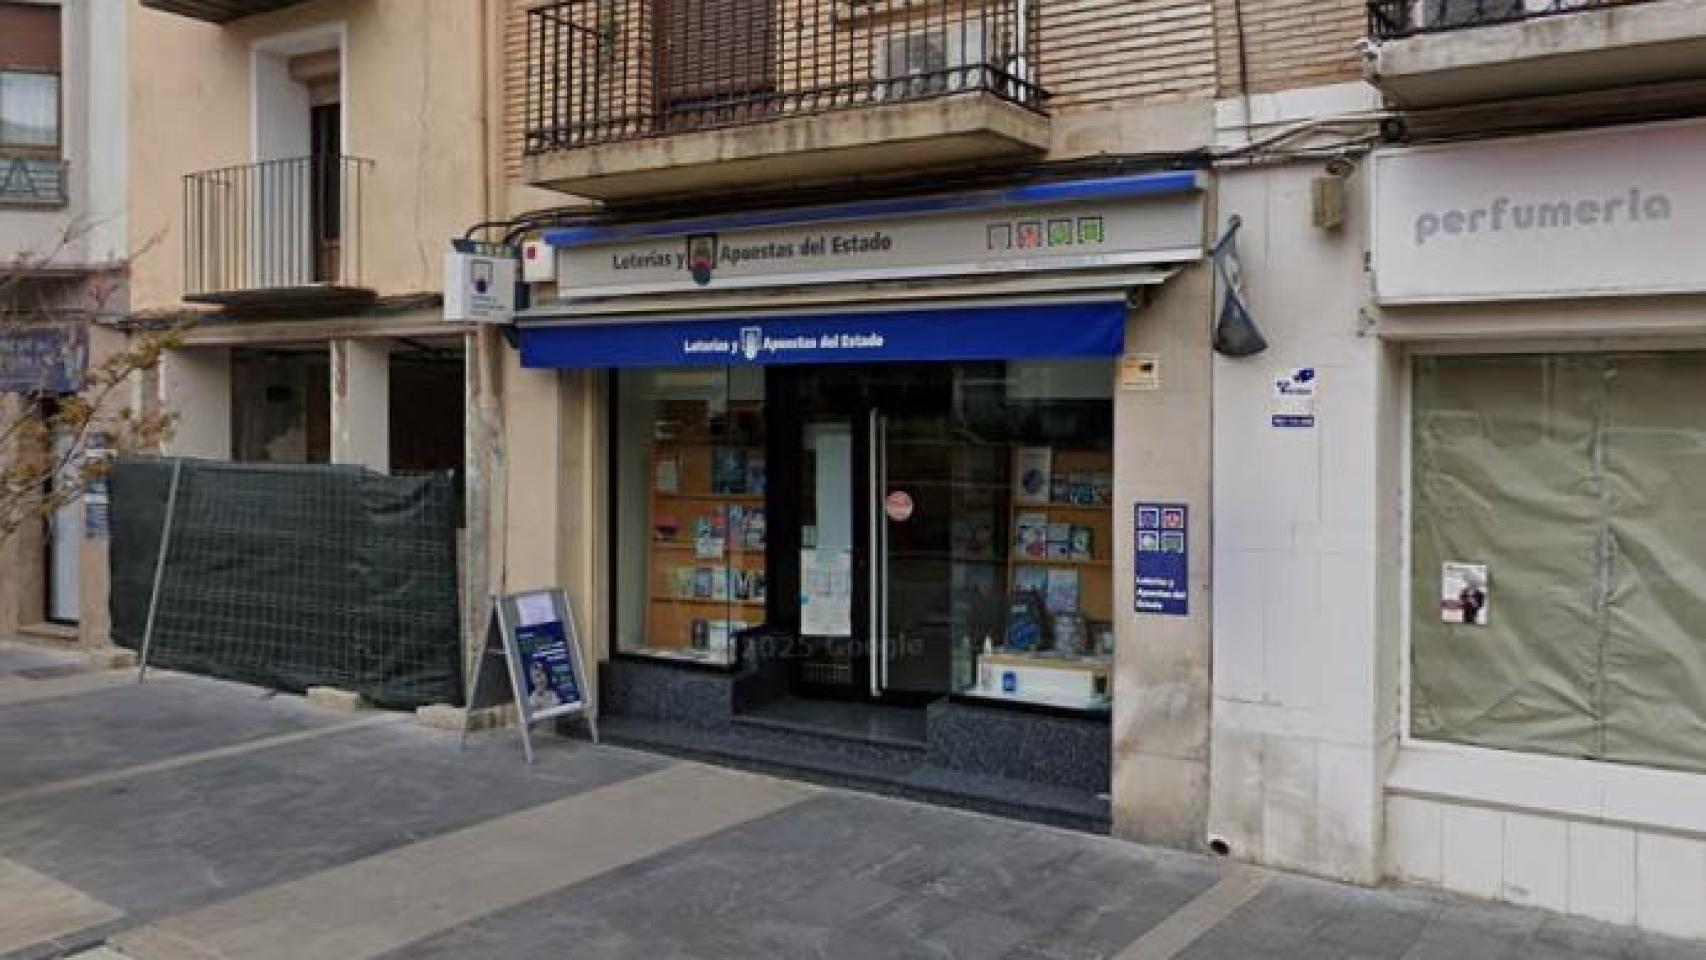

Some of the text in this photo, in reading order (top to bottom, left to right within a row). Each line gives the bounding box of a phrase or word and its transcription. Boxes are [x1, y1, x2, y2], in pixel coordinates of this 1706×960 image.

[613, 231, 892, 270] Loterías y Apuestas del Estado
[763, 336, 816, 353] Apuestas
[820, 334, 839, 349] del
[841, 332, 884, 348] Estado
